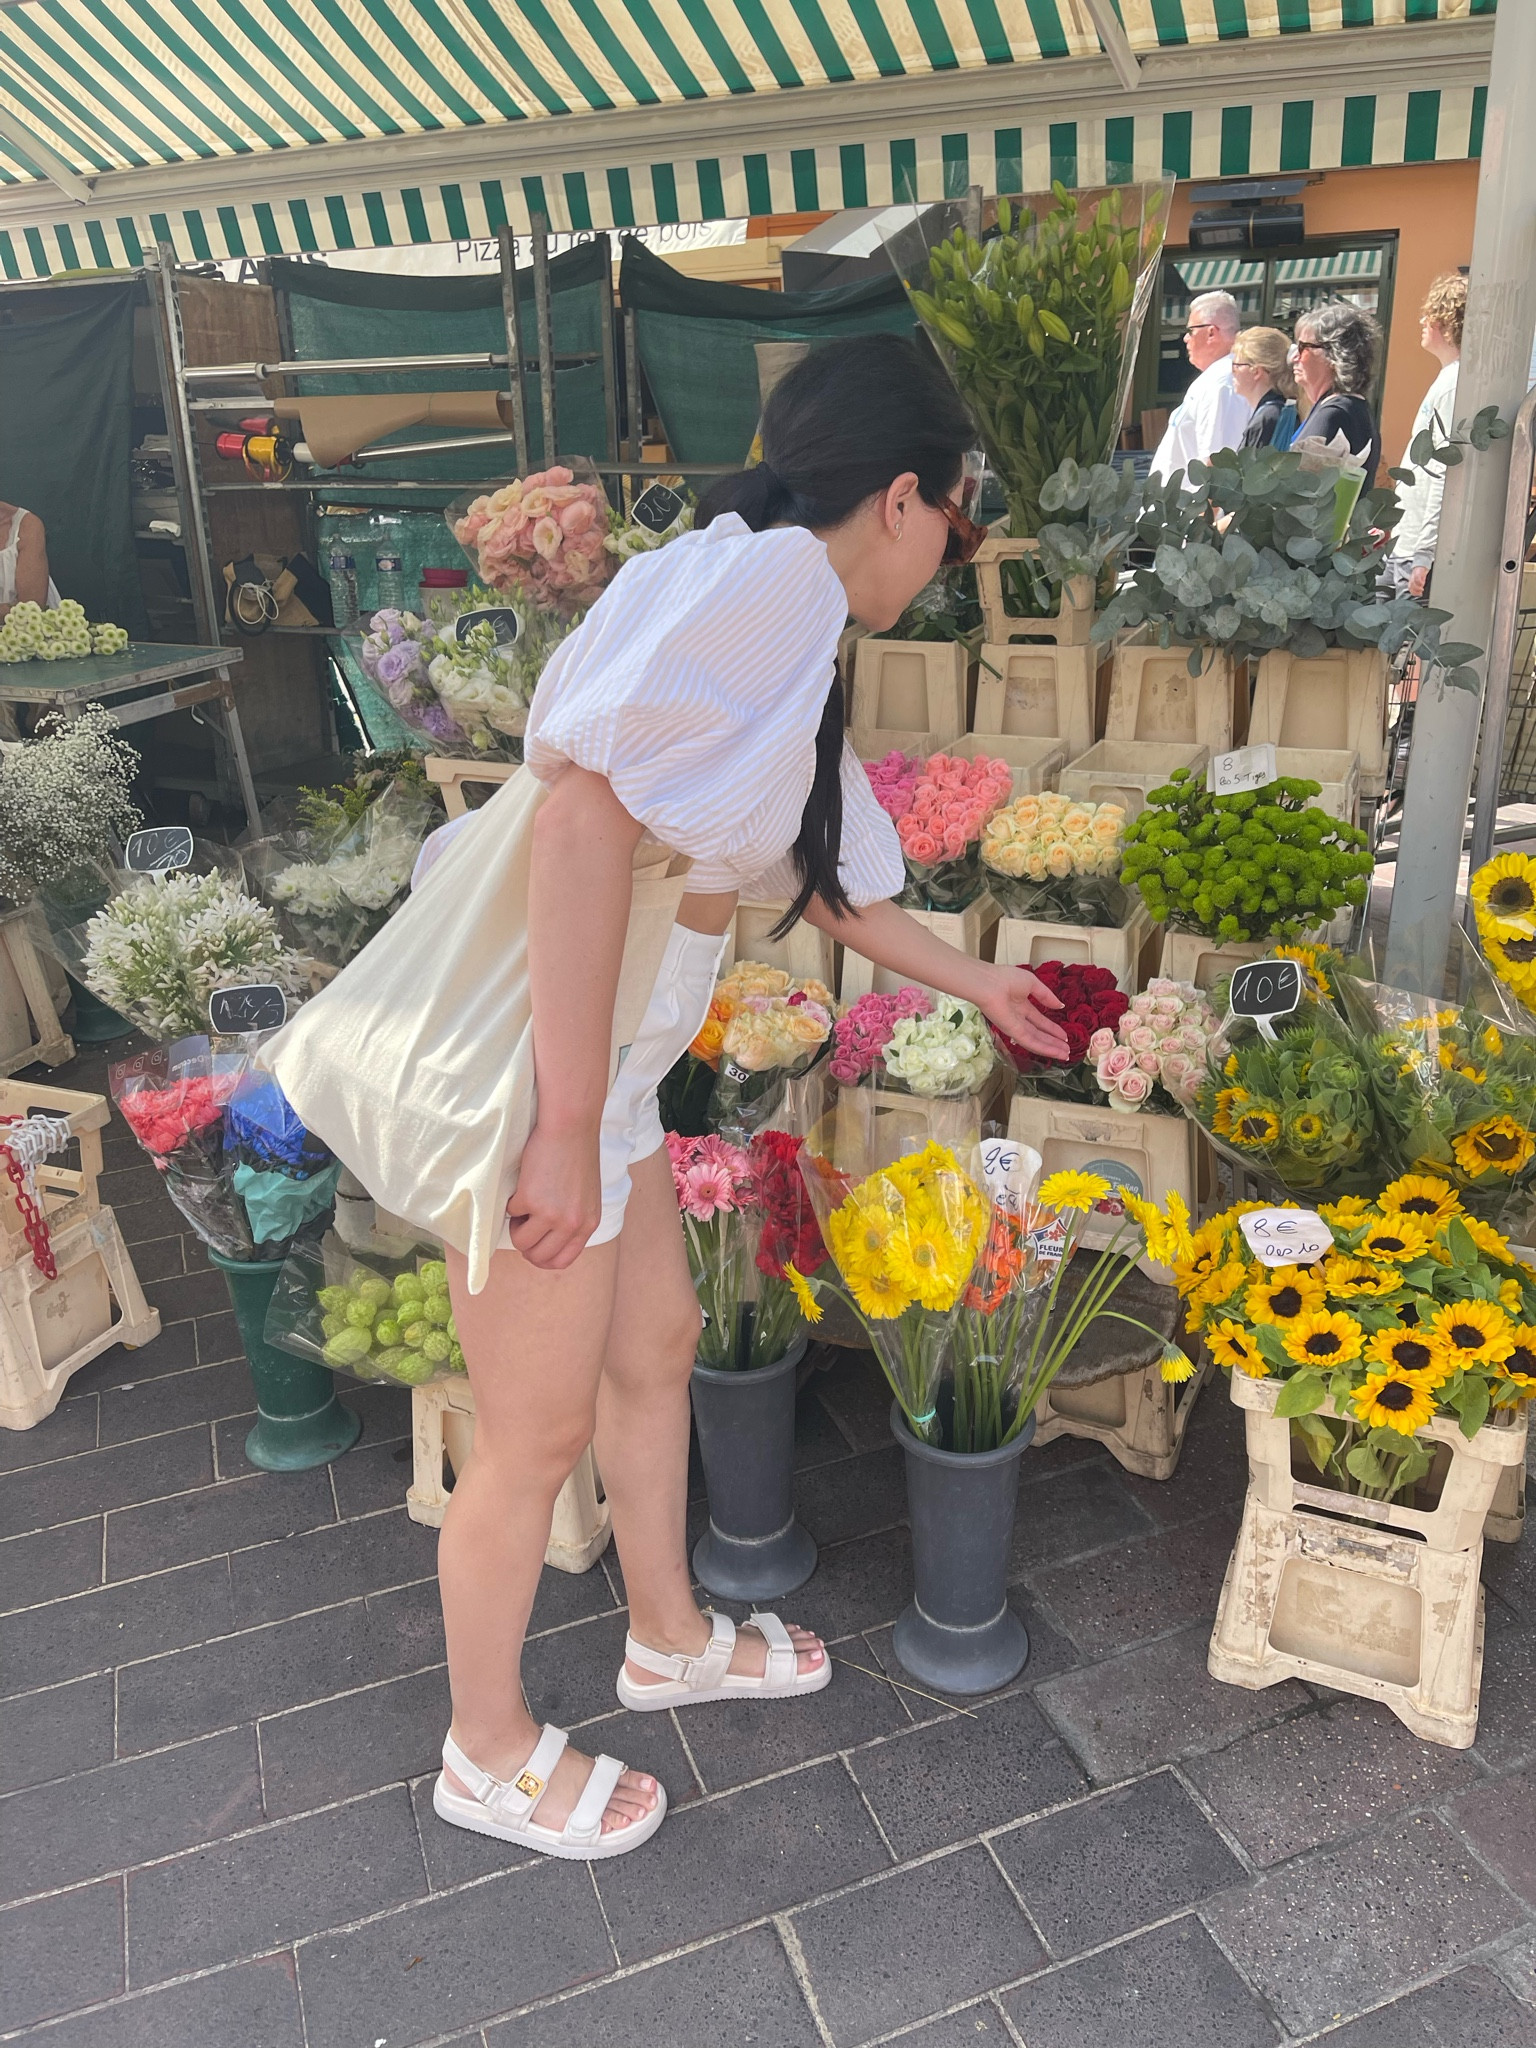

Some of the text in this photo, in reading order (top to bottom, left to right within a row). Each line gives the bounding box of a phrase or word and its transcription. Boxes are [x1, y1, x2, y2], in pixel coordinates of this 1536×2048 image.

[1222, 756, 1233, 771] 8
[1233, 966, 1298, 1004] 10€
[728, 1067, 747, 1081] 30
[1039, 1244, 1064, 1253] FLEUR
